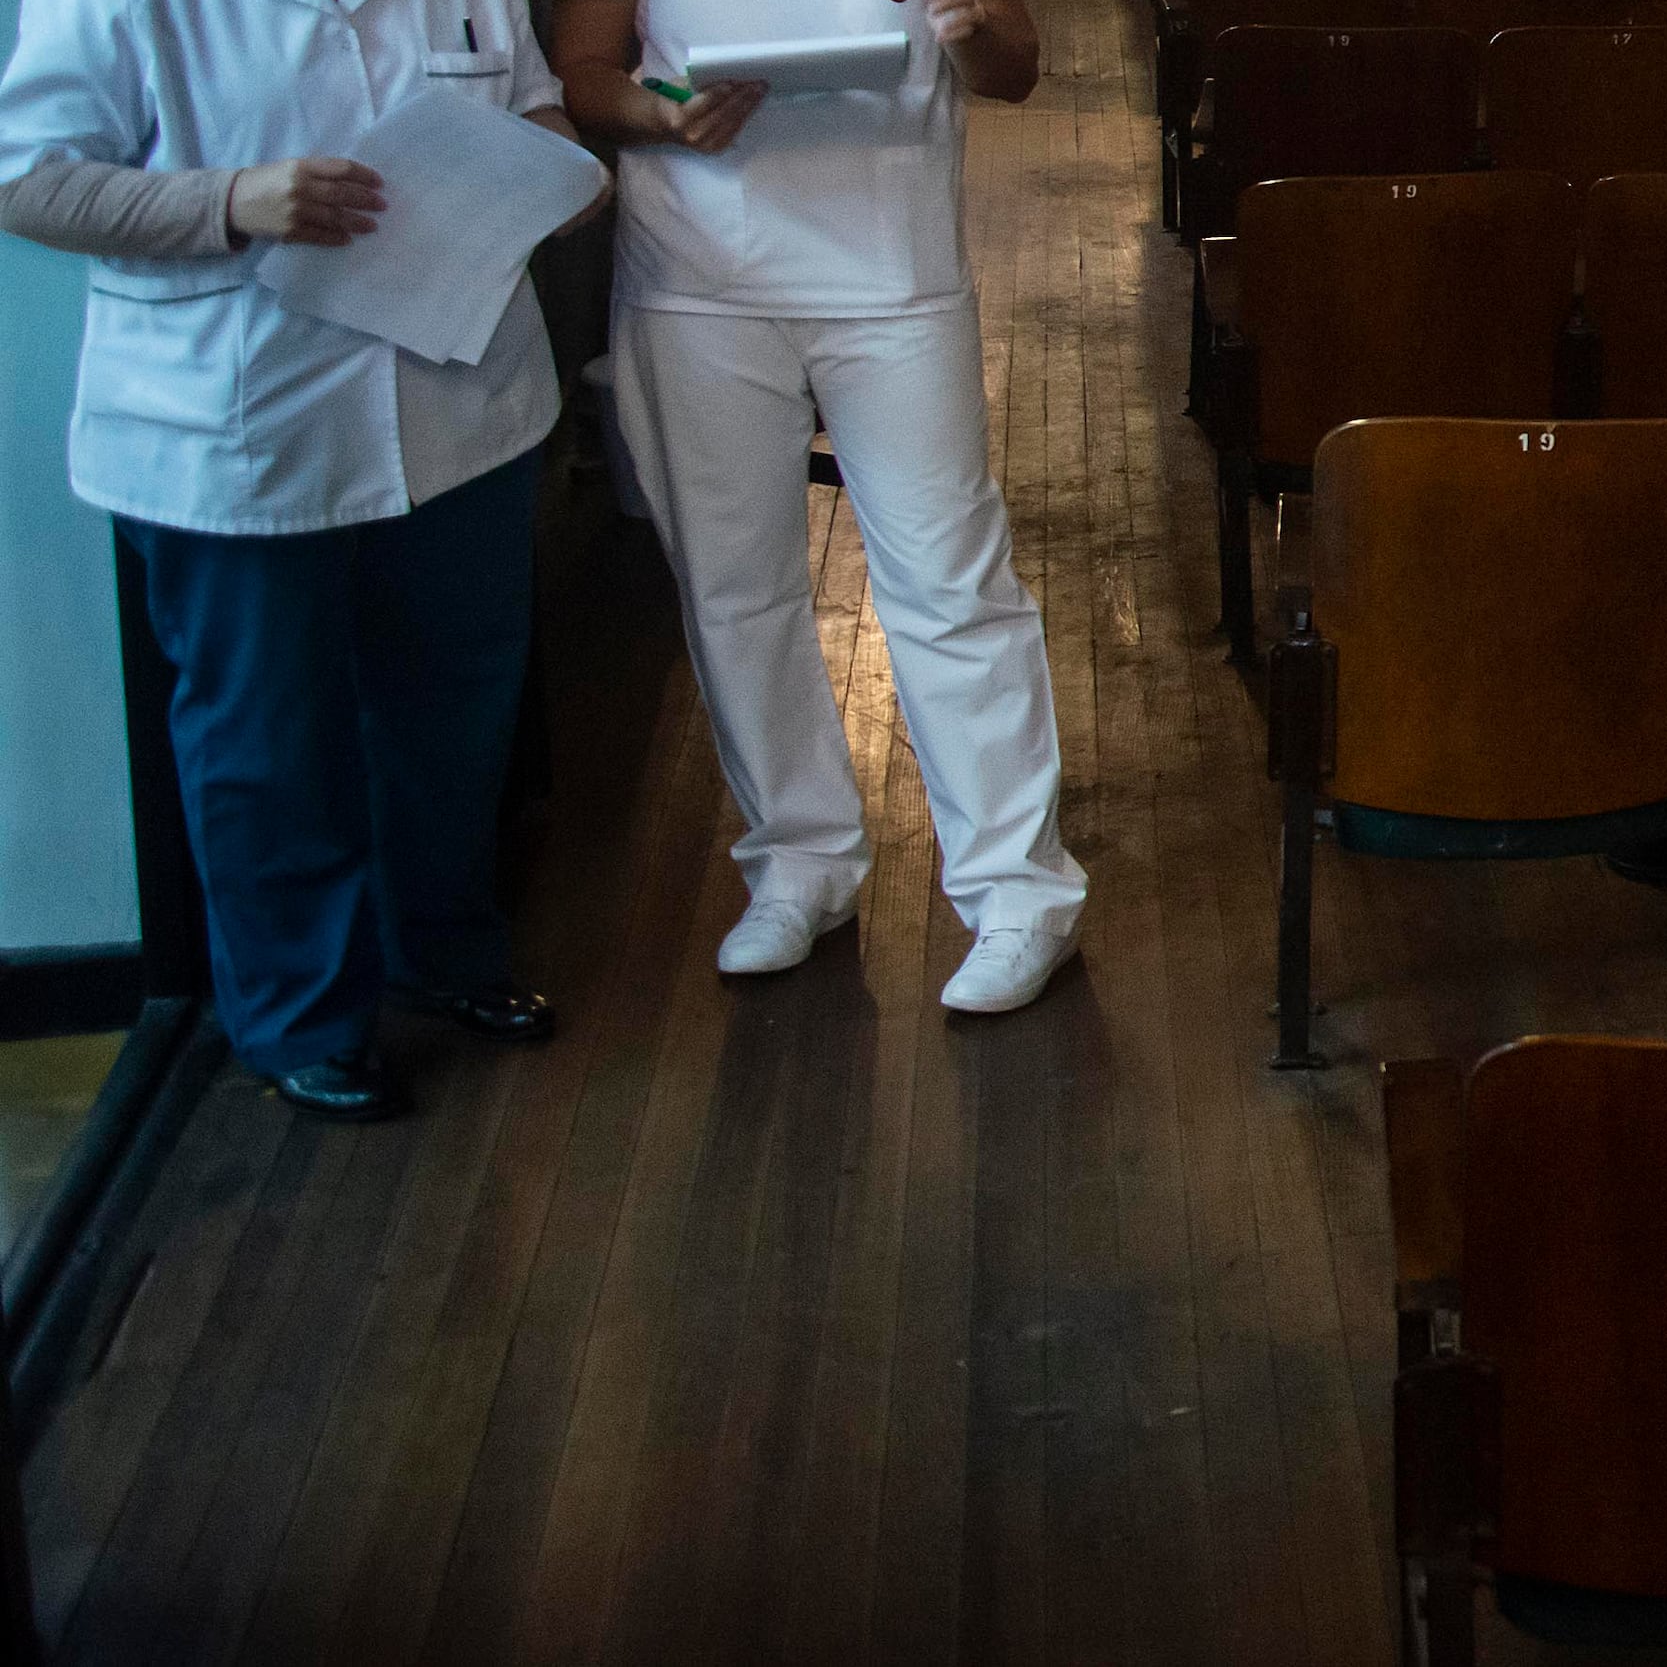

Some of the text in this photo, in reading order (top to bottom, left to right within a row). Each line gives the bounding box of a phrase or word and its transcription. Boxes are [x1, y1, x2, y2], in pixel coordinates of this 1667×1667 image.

[1328, 34, 1350, 47] 19
[1612, 32, 1633, 45] 17
[1391, 184, 1417, 199] 19
[1518, 433, 1555, 452] 19
